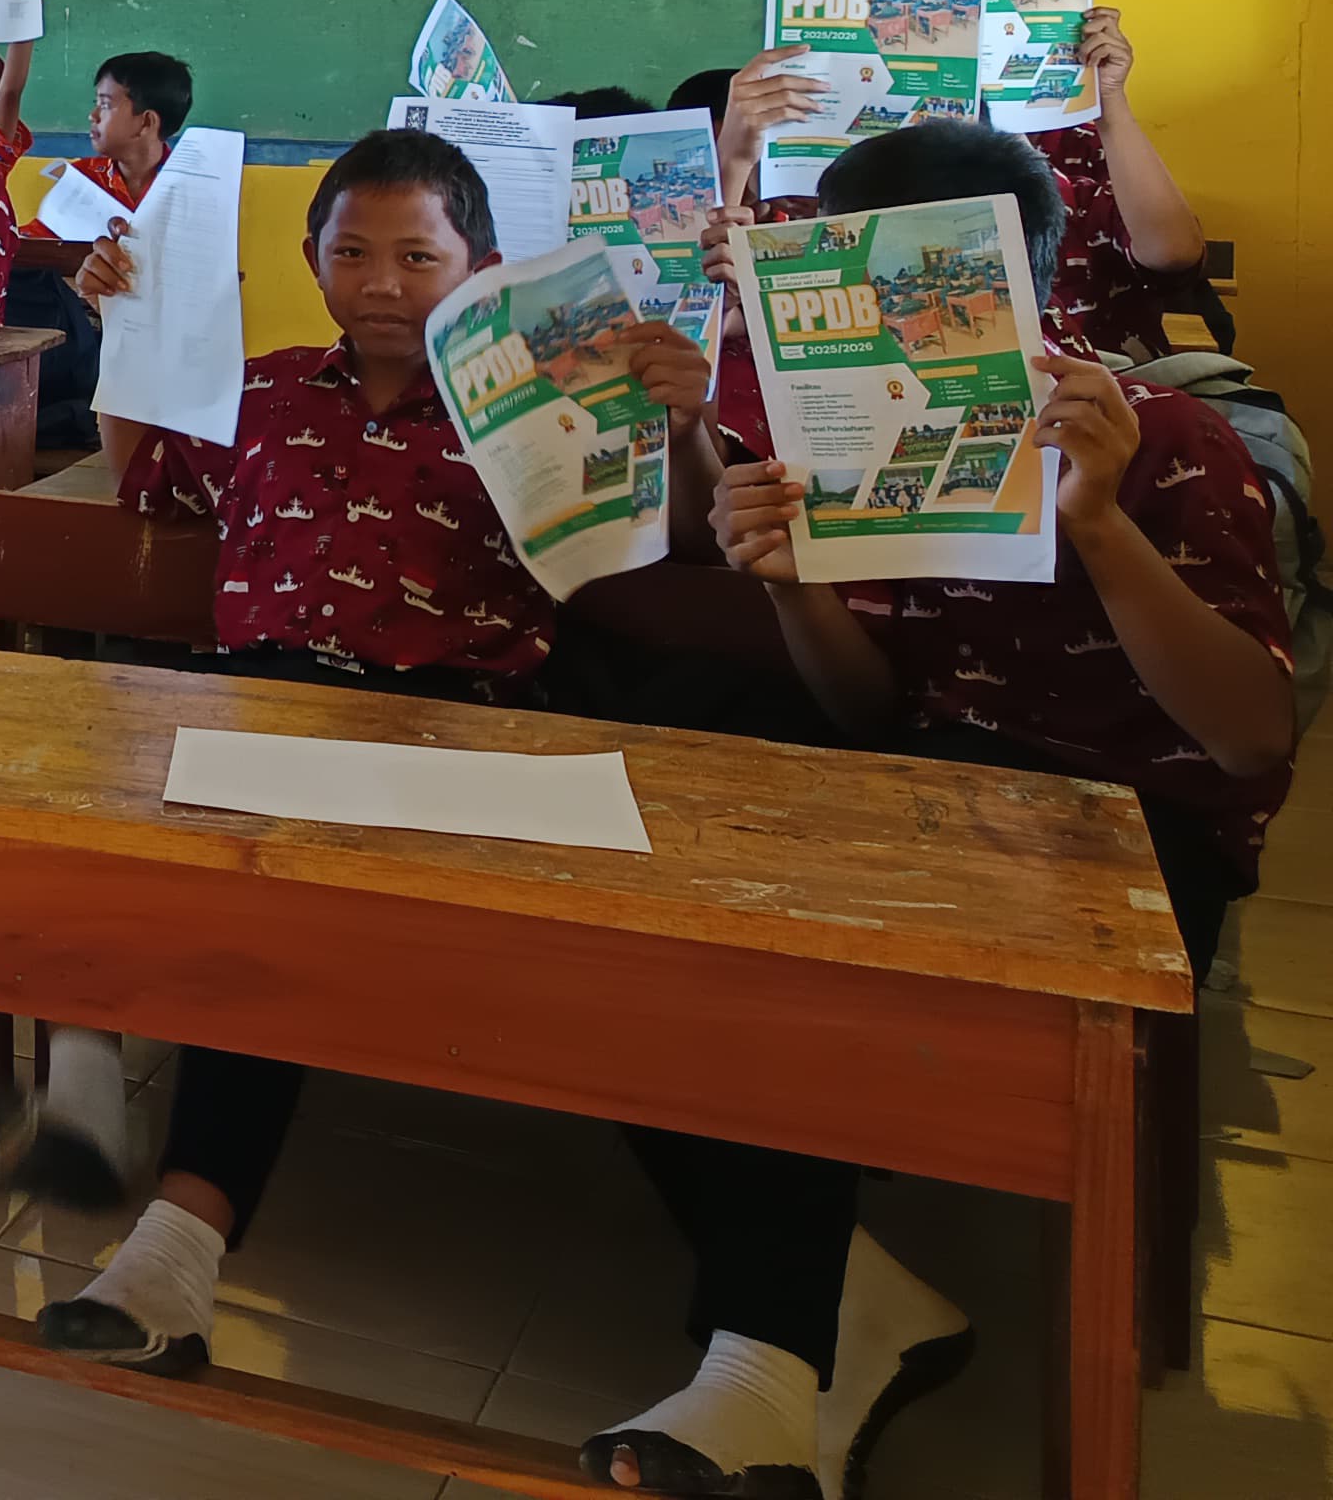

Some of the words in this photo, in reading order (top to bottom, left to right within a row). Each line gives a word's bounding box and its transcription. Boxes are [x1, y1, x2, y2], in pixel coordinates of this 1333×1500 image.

[803, 31, 858, 40] 2025/2026
[571, 178, 631, 216] PDB
[768, 284, 882, 334] PPDB
[807, 342, 874, 356] 2025/2026
[451, 331, 536, 411] PPDB
